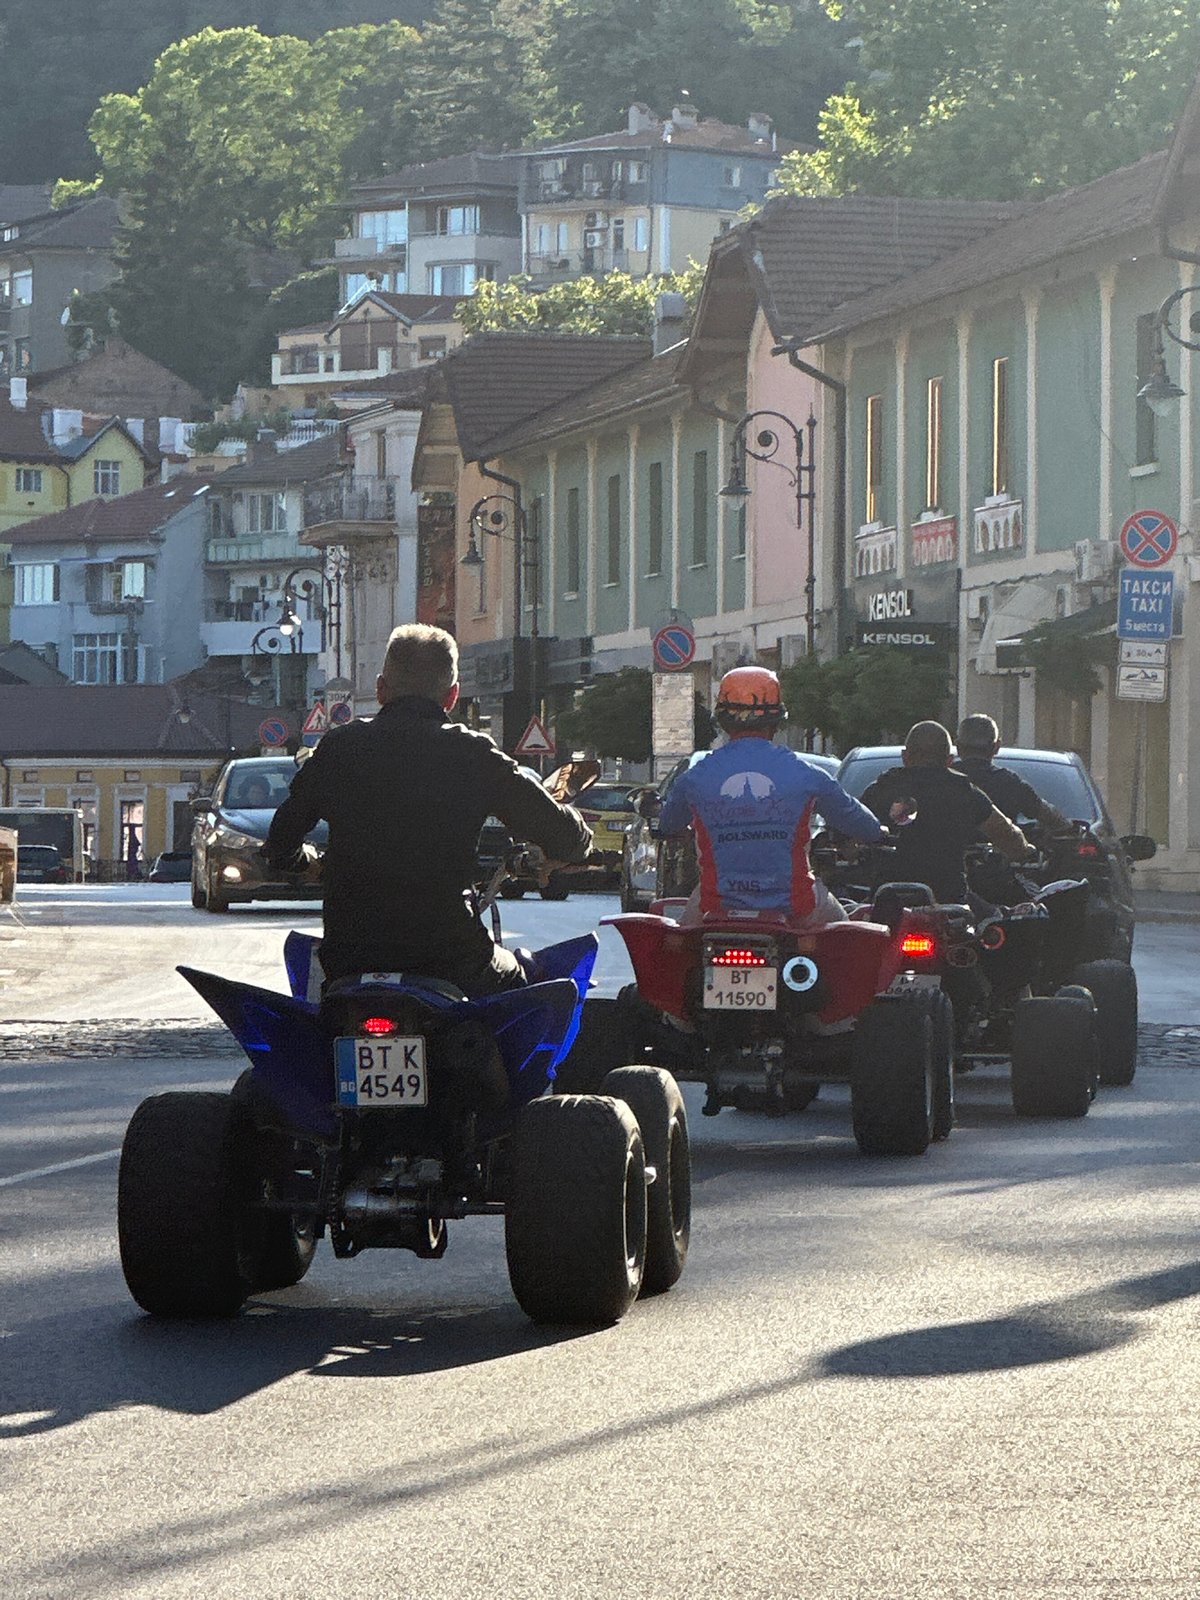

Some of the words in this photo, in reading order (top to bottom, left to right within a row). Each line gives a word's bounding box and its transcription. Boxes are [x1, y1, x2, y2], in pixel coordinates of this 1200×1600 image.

[1122, 579, 1171, 595] ТАКСИ
[869, 589, 912, 622] KENSOL
[1131, 598, 1163, 613] TAXI
[863, 633, 936, 646] KENSOL
[717, 829, 789, 844] BOLSWARD
[731, 970, 751, 984] BT
[715, 991, 767, 1006] 11590
[358, 1045, 392, 1069] BT
[403, 1045, 419, 1069] K
[360, 1074, 420, 1099] 4549
